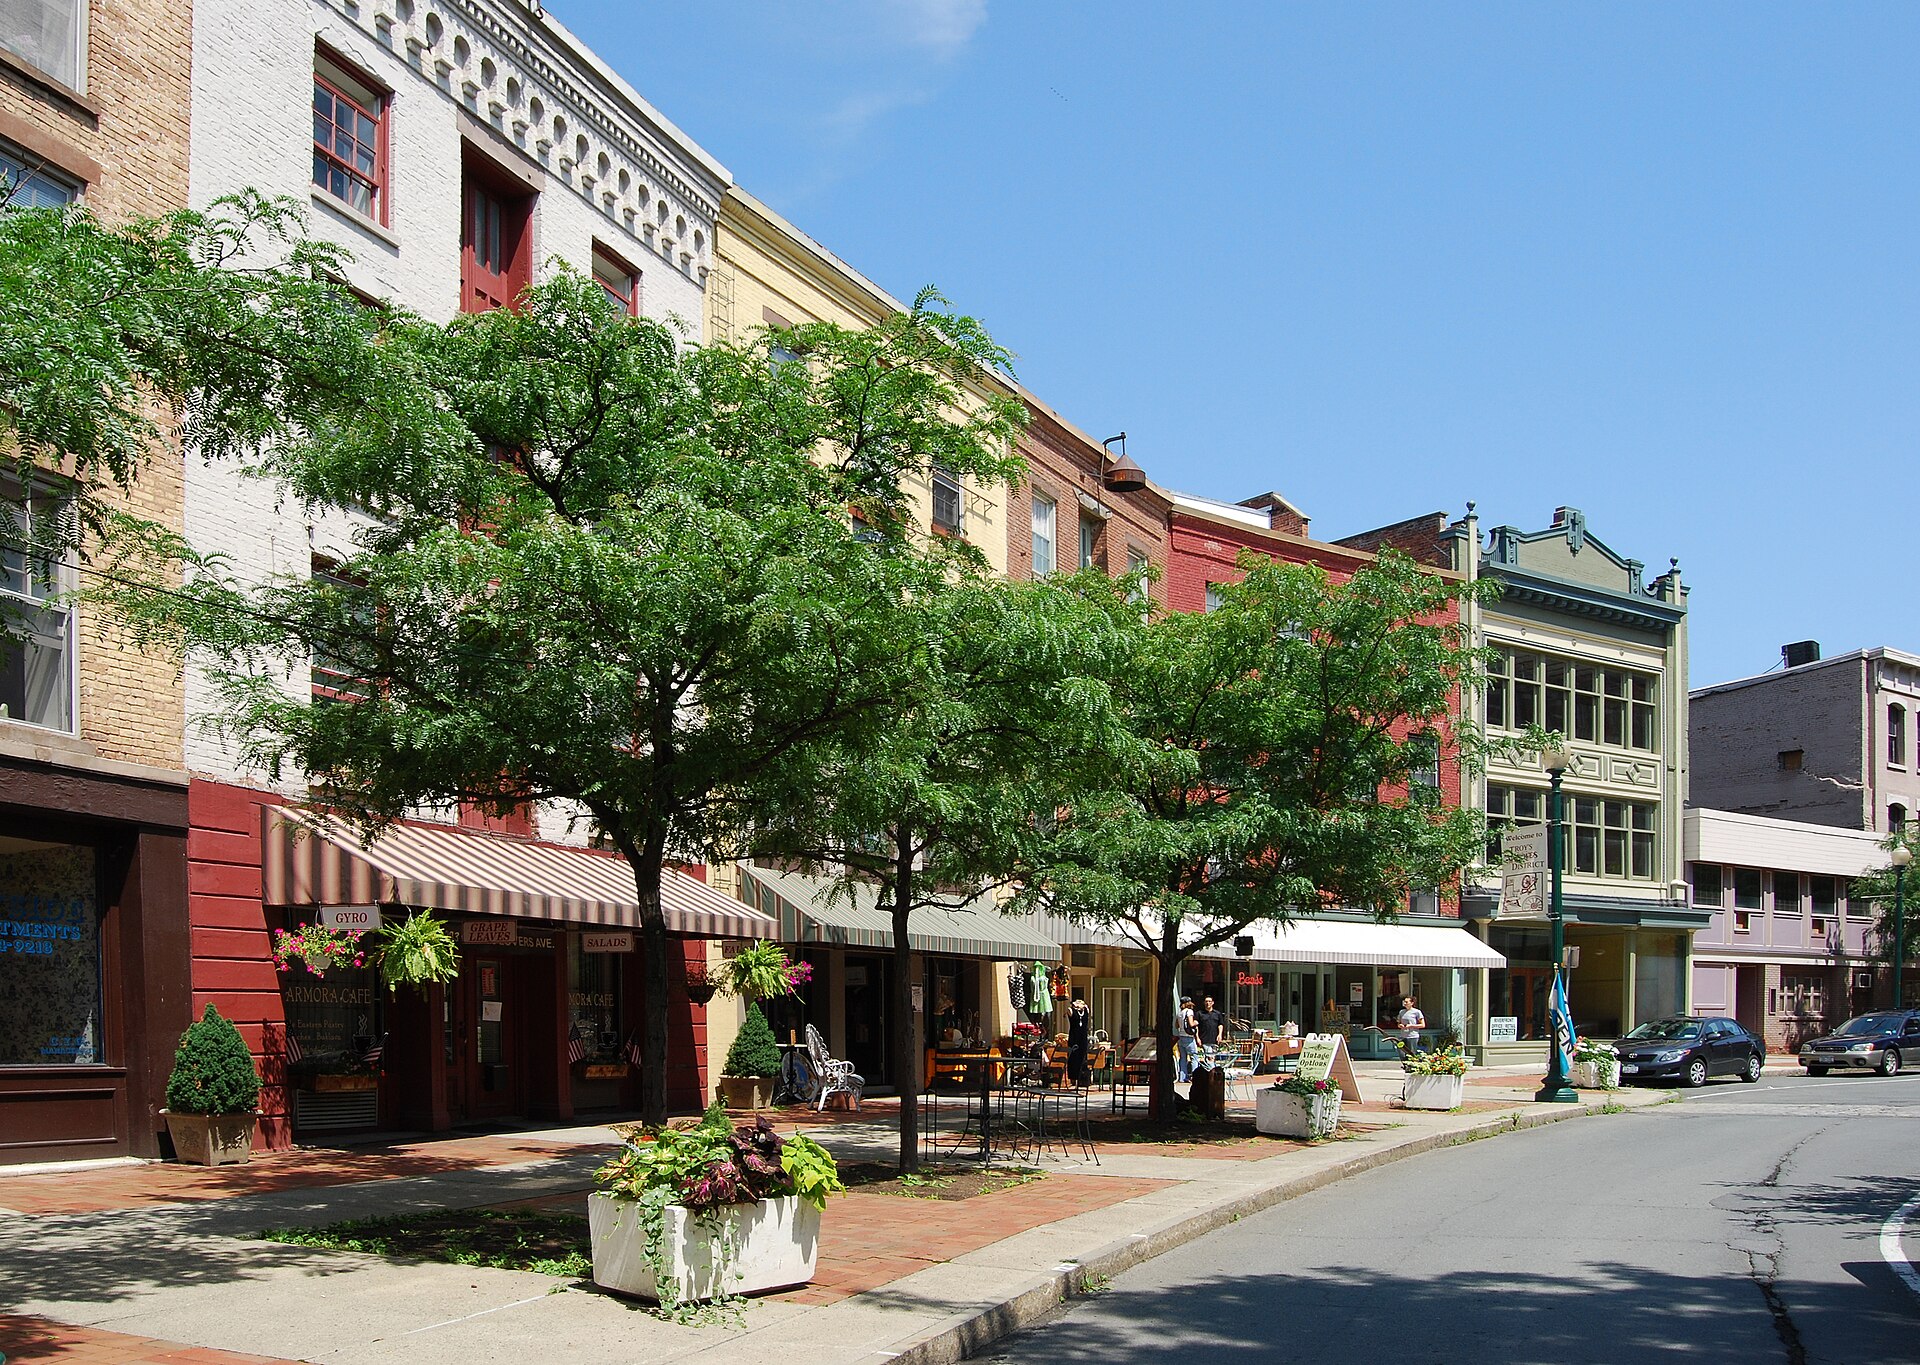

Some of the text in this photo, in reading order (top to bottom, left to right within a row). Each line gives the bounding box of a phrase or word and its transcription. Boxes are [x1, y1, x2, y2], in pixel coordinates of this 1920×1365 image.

[1505, 833, 1535, 842] Welcome
[1511, 861, 1544, 870] DISTRICT
[335, 911, 368, 925] GYRO
[470, 922, 508, 932] GRAPE
[469, 931, 511, 942] LEAVES
[535, 938, 555, 949] AVE.
[587, 938, 627, 948] SALADS
[1237, 971, 1263, 986] Beads
[340, 987, 371, 1004] CAFE
[592, 993, 614, 1007] CAFE
[1303, 1051, 1330, 1060] Vintage
[1299, 1060, 1327, 1068] Options
